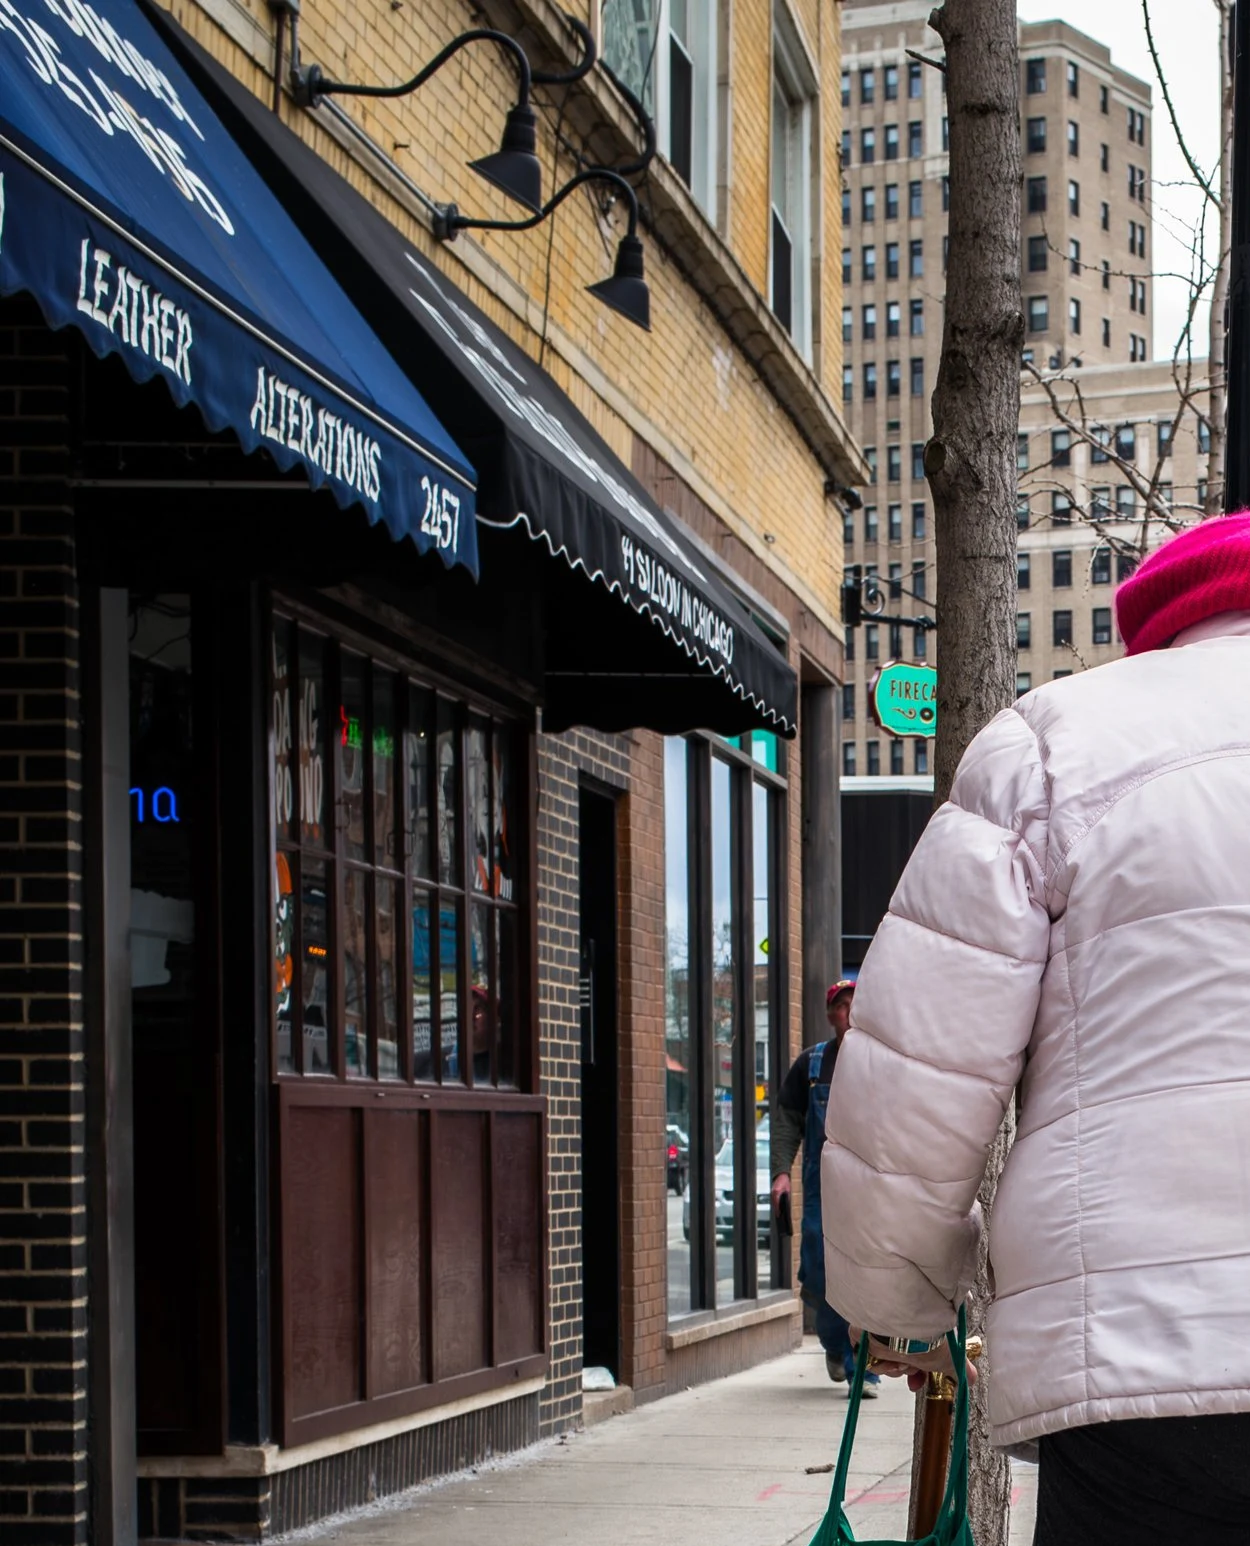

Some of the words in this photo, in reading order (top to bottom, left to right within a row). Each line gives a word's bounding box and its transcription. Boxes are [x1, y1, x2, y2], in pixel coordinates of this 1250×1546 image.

[76, 238, 193, 386] LEATHER
[250, 366, 382, 503] ALTERATIONS
[420, 476, 461, 554] 2457
[681, 586, 693, 630] IN
[692, 597, 734, 664] CHICAGO
